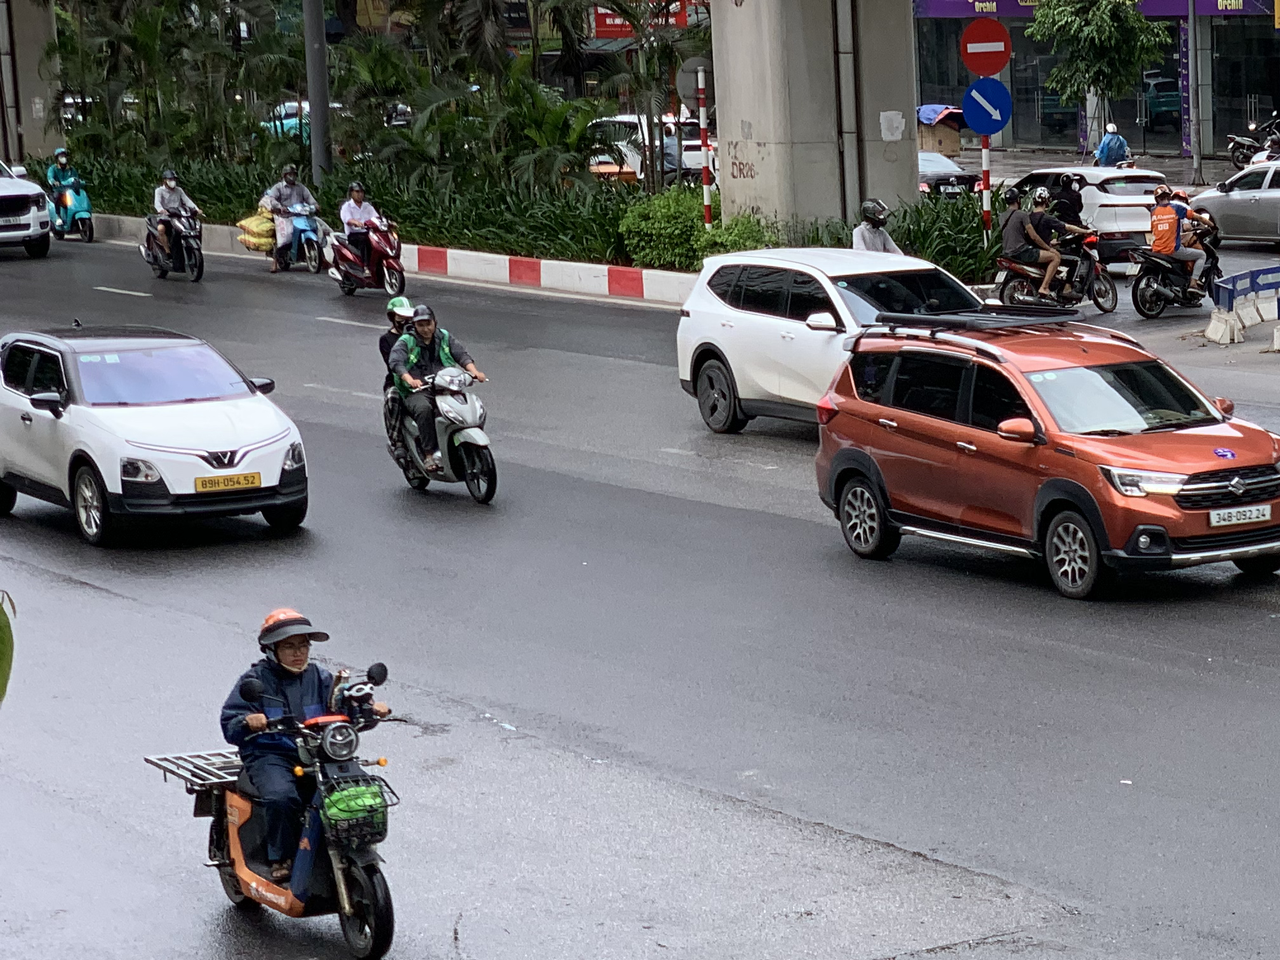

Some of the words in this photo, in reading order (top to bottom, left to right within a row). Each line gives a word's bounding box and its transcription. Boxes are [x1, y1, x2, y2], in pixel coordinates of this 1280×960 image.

[974, 1, 997, 13] Orchid
[731, 161, 756, 180] DR26
[200, 475, 256, 490] 89H-054.52
[1215, 507, 1267, 524] 34B-092.24
